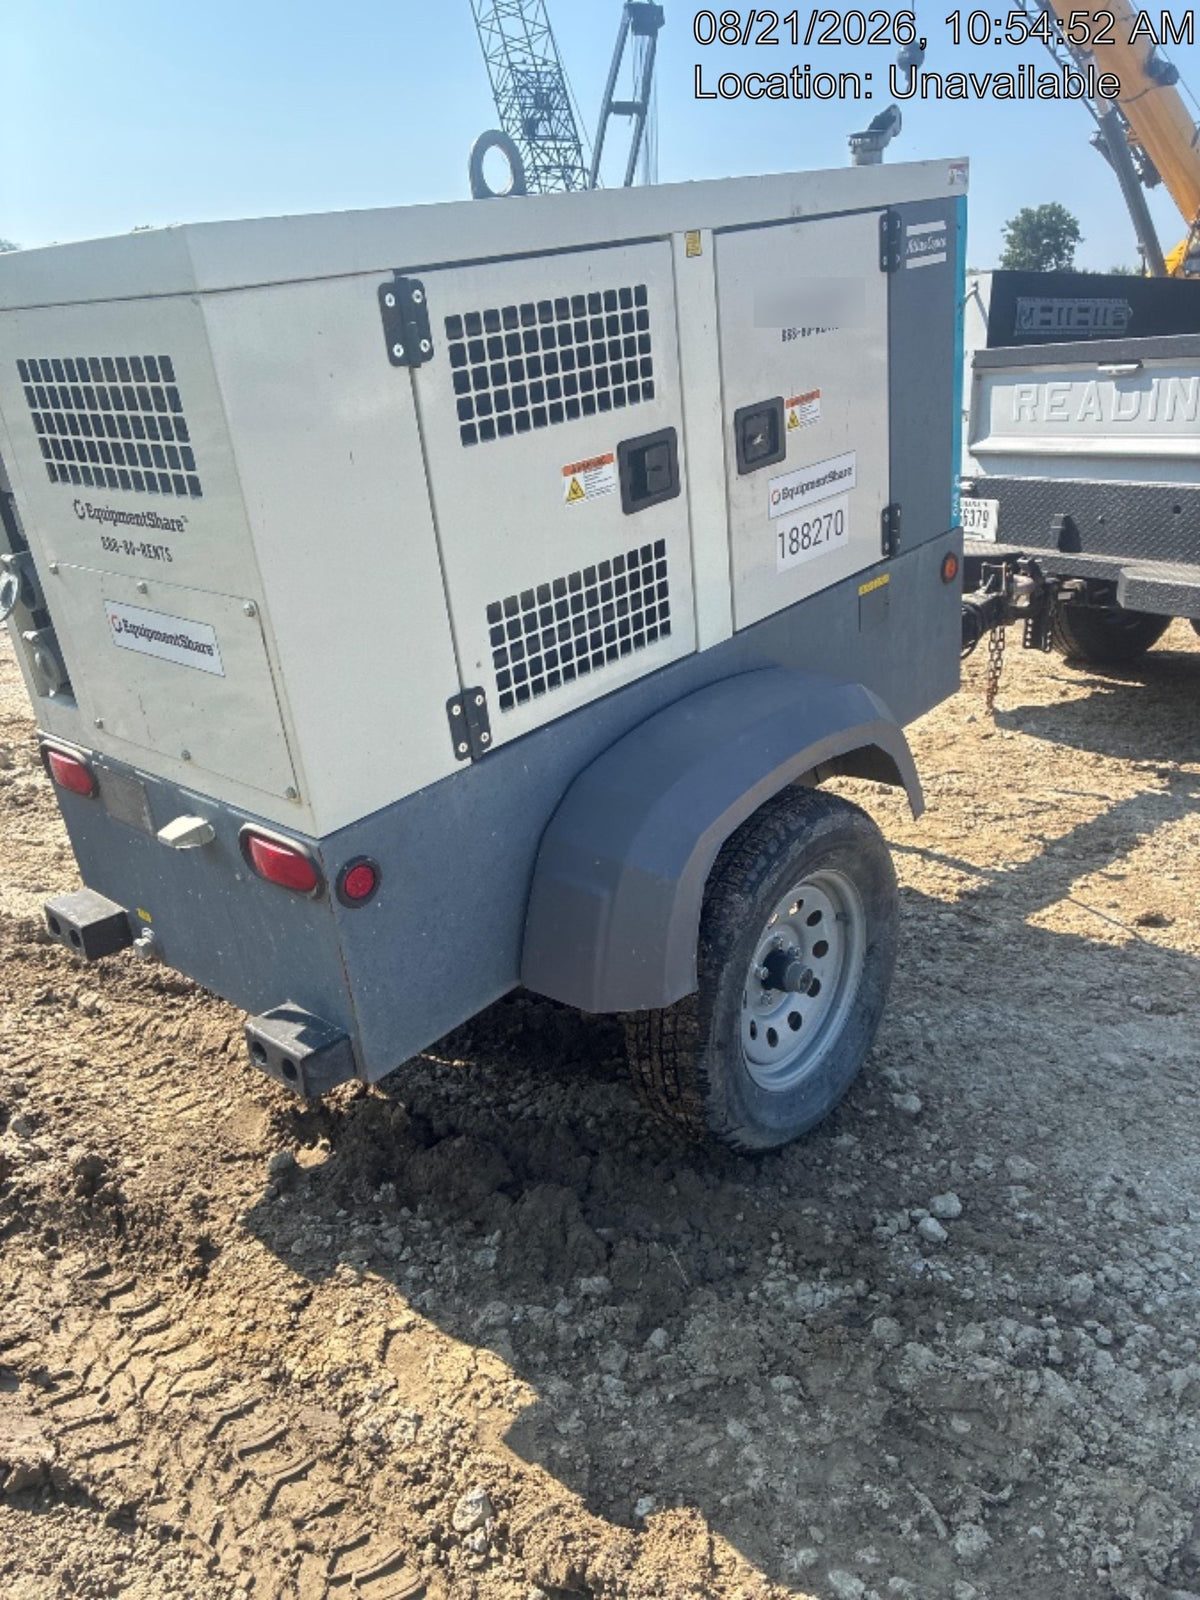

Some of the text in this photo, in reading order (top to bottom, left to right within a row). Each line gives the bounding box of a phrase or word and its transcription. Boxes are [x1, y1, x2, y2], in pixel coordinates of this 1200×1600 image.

[781, 467, 853, 501] EquipmentShare
[778, 509, 844, 559] 188270
[122, 619, 215, 656] EquipmentShare
